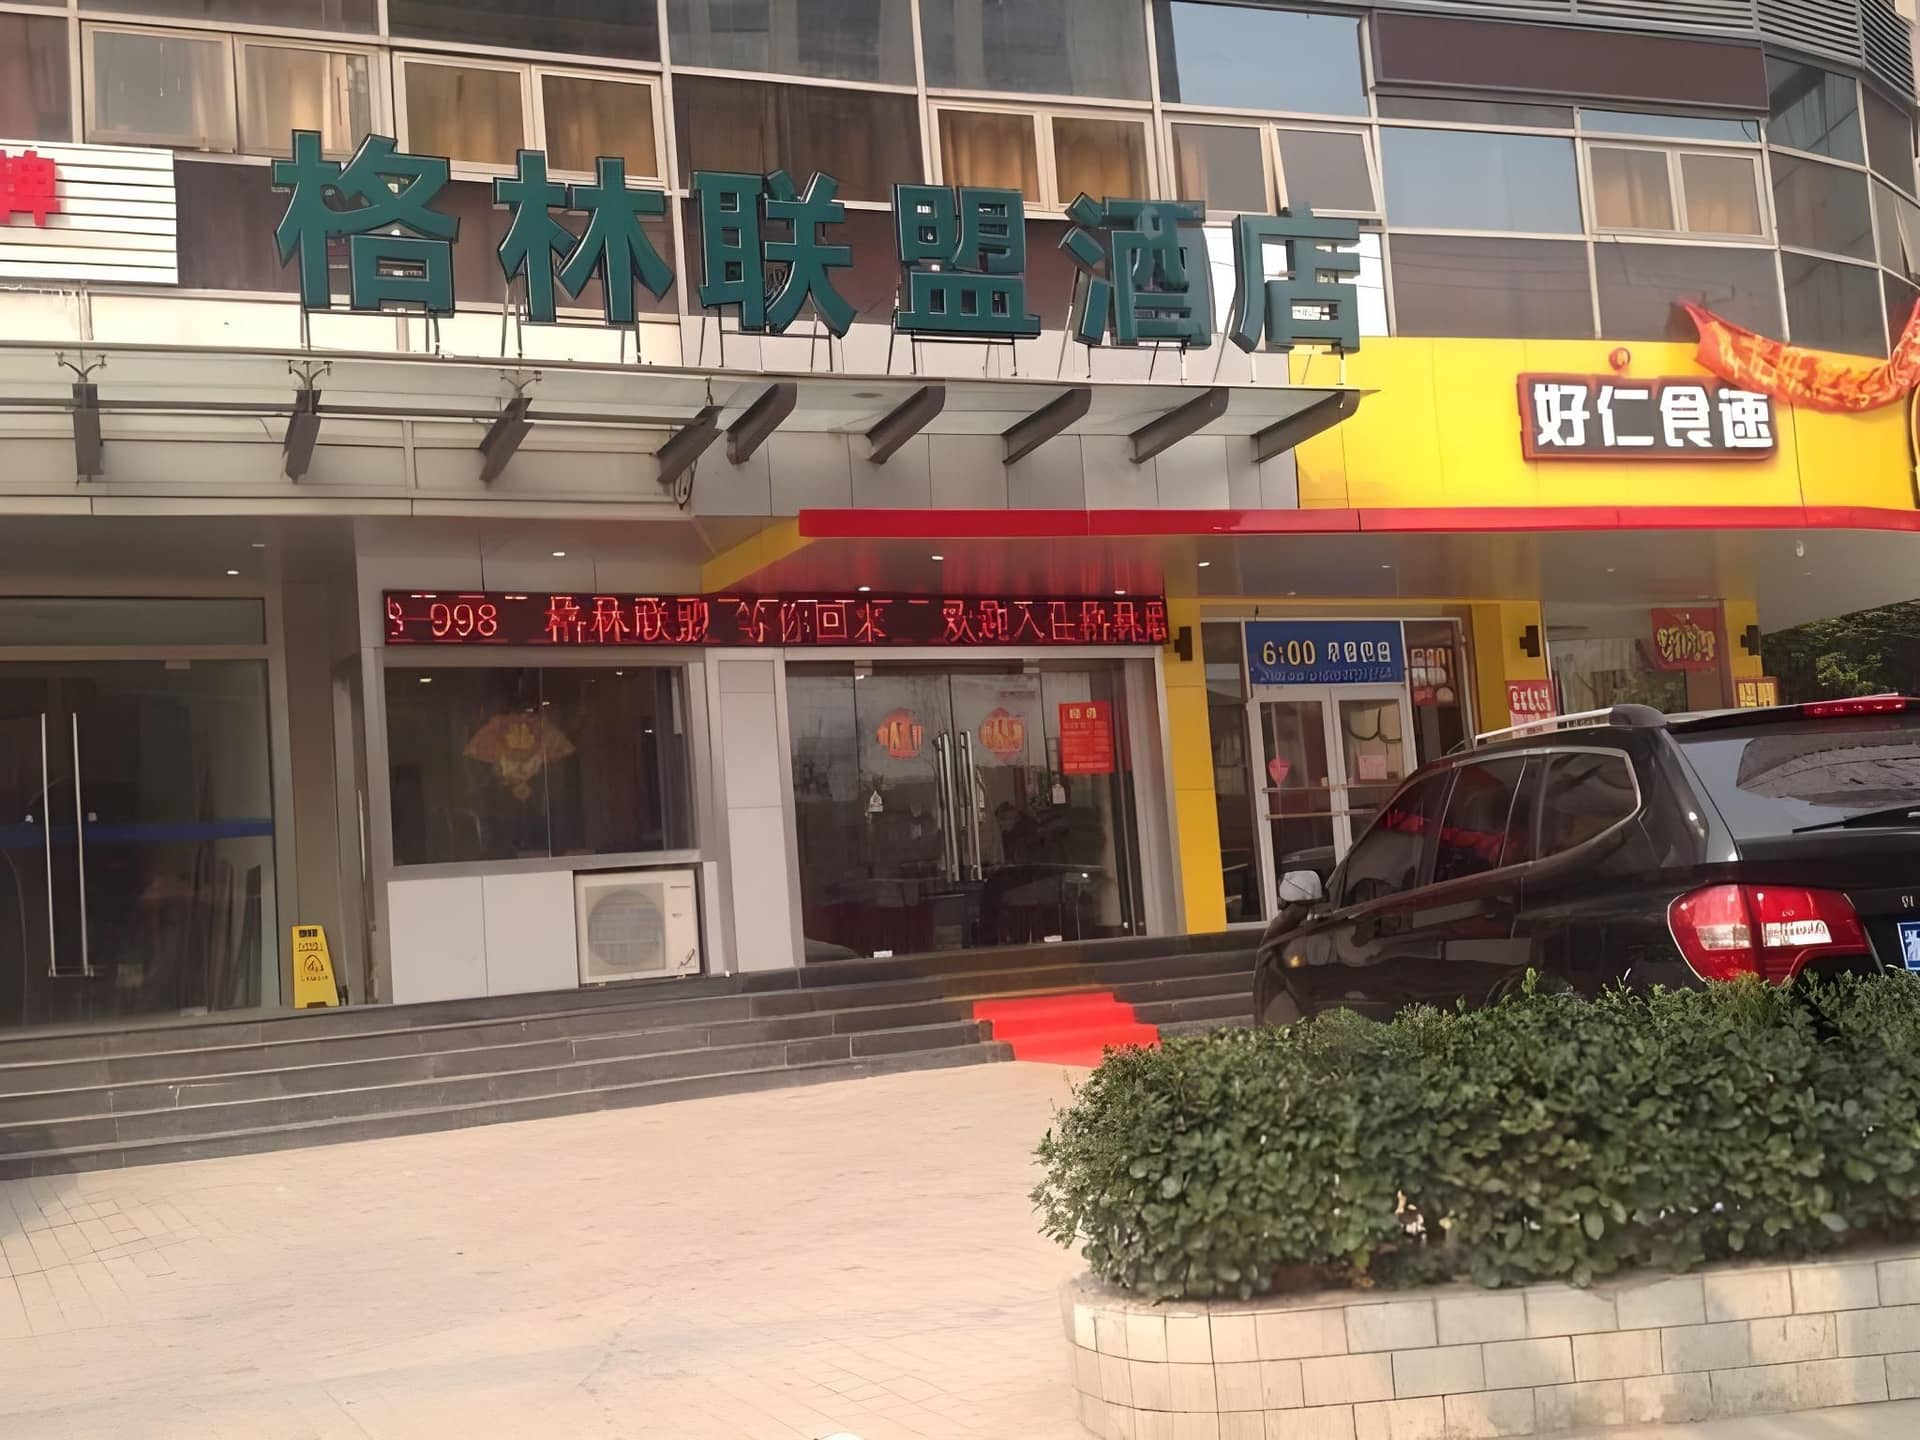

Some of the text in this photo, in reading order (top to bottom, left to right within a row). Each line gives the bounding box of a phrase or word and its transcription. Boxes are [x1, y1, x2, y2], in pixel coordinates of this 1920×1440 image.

[271, 129, 1361, 353] 格林联盟酒店
[1533, 383, 1774, 448] 好仁食速
[1262, 639, 1317, 666] 6:00
